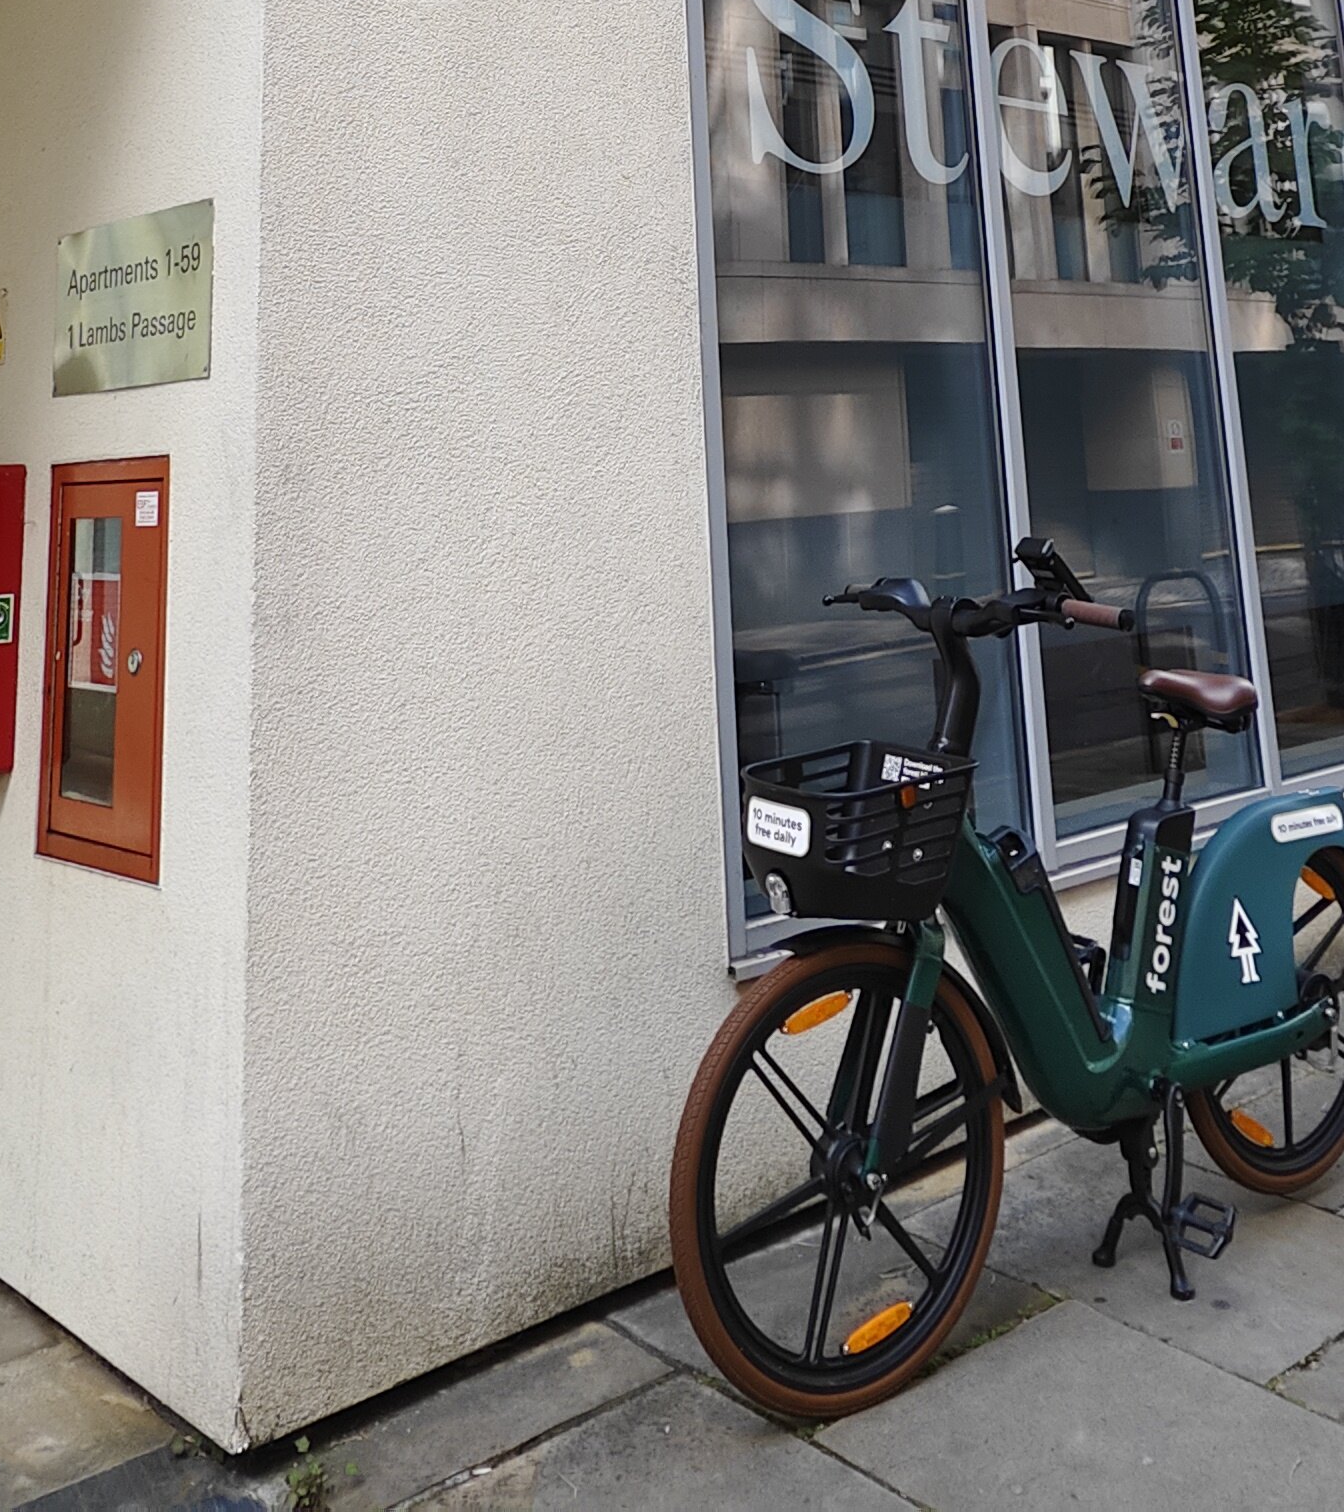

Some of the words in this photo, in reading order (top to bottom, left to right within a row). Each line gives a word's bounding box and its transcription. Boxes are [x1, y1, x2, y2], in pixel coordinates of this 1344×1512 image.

[67, 255, 159, 301] Apartments
[165, 242, 201, 277] 1-59
[68, 324, 74, 350] 1
[79, 316, 127, 348] Lambs
[131, 309, 197, 340] Passage
[753, 807, 763, 820] 10
[765, 812, 803, 831] minutes
[755, 822, 771, 838] free
[773, 829, 797, 848] daily
[1145, 855, 1183, 995] forest
